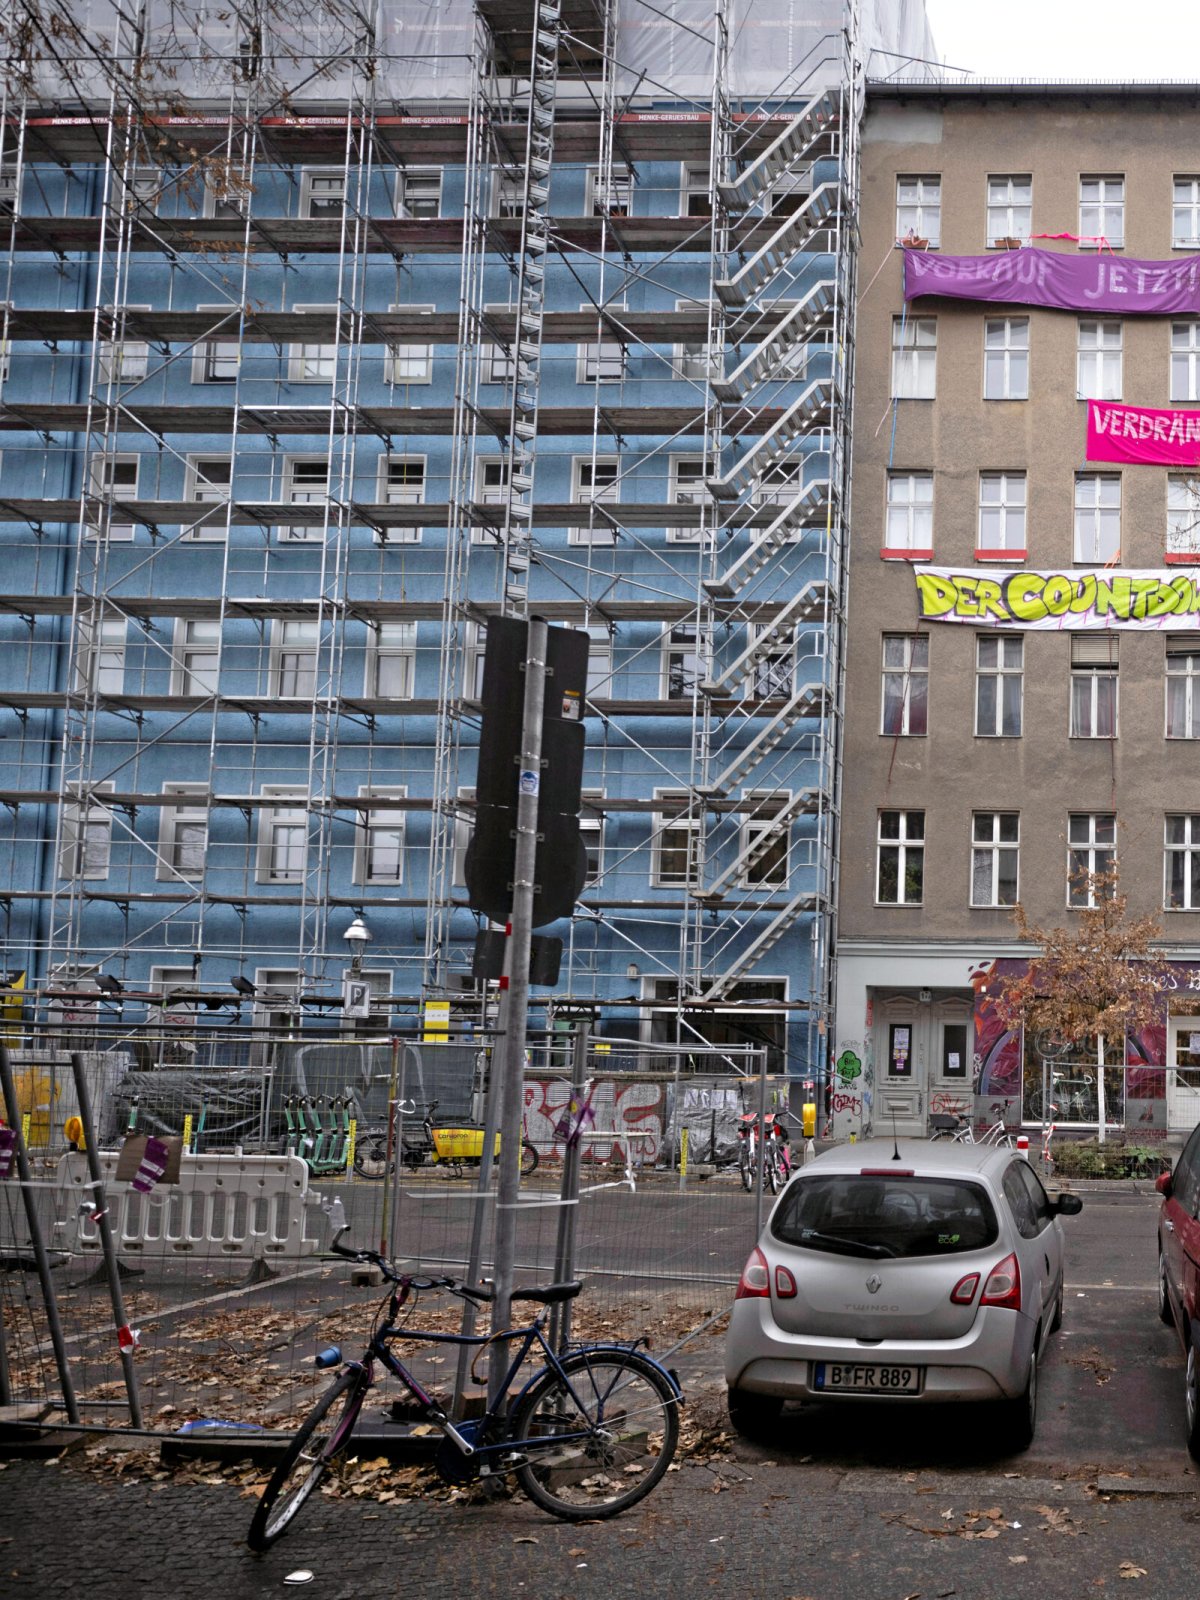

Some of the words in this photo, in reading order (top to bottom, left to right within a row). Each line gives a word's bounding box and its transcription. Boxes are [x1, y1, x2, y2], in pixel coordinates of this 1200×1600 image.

[911, 254, 1056, 288] VORKAUF
[1083, 263, 1198, 300] JETZT!
[916, 573, 1012, 622] DER
[353, 987, 363, 1003] P
[845, 1304, 900, 1313] TWINGO
[831, 1366, 843, 1385] B
[853, 1367, 876, 1386] FR
[879, 1368, 912, 1388] 889
